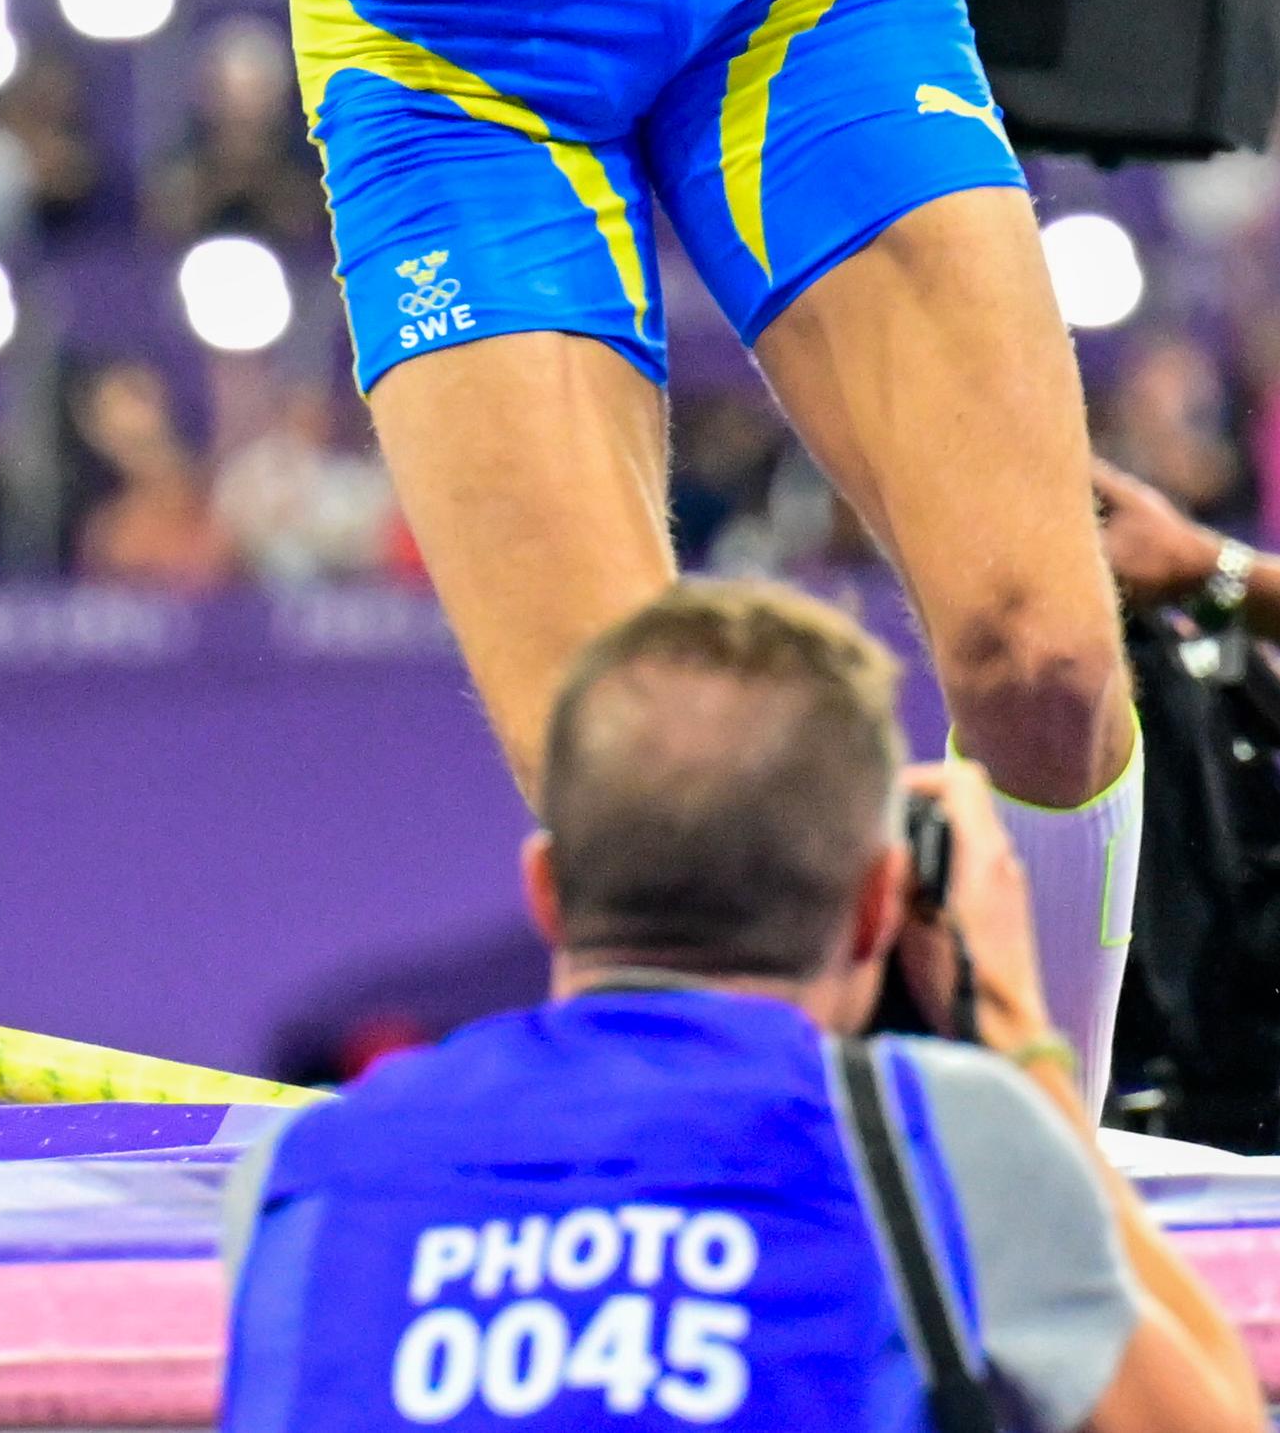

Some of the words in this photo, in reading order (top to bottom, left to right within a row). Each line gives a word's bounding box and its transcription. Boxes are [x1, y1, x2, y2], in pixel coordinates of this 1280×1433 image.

[399, 303, 477, 349] SWE
[408, 1204, 759, 1305] PHOTO
[391, 1293, 751, 1425] 0045
